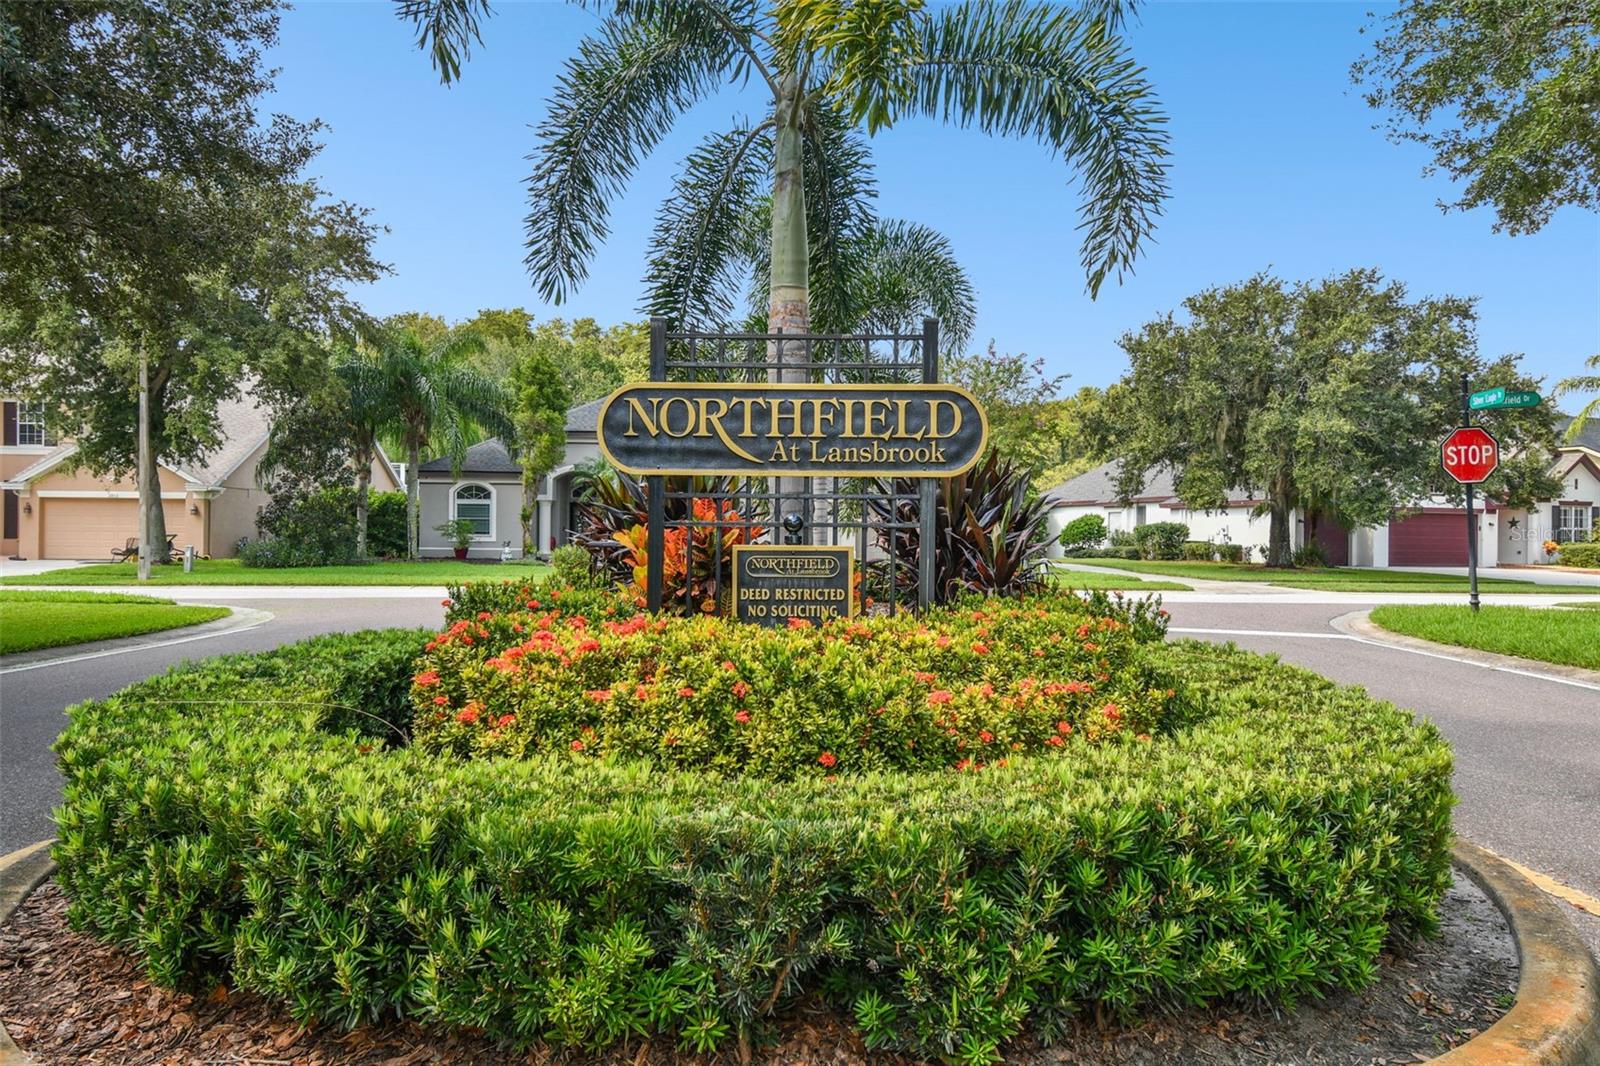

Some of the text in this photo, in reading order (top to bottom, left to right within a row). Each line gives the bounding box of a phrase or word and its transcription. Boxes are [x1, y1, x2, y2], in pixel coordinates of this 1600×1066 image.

[623, 397, 963, 463] NORTHFIELD
[768, 439, 946, 464] At Lansbrook
[1446, 445, 1493, 466] STOP
[751, 558, 835, 574] NORTHFIELD
[740, 588, 845, 600] DEED RESTRICTED
[748, 605, 838, 617] NO SOLICITING
